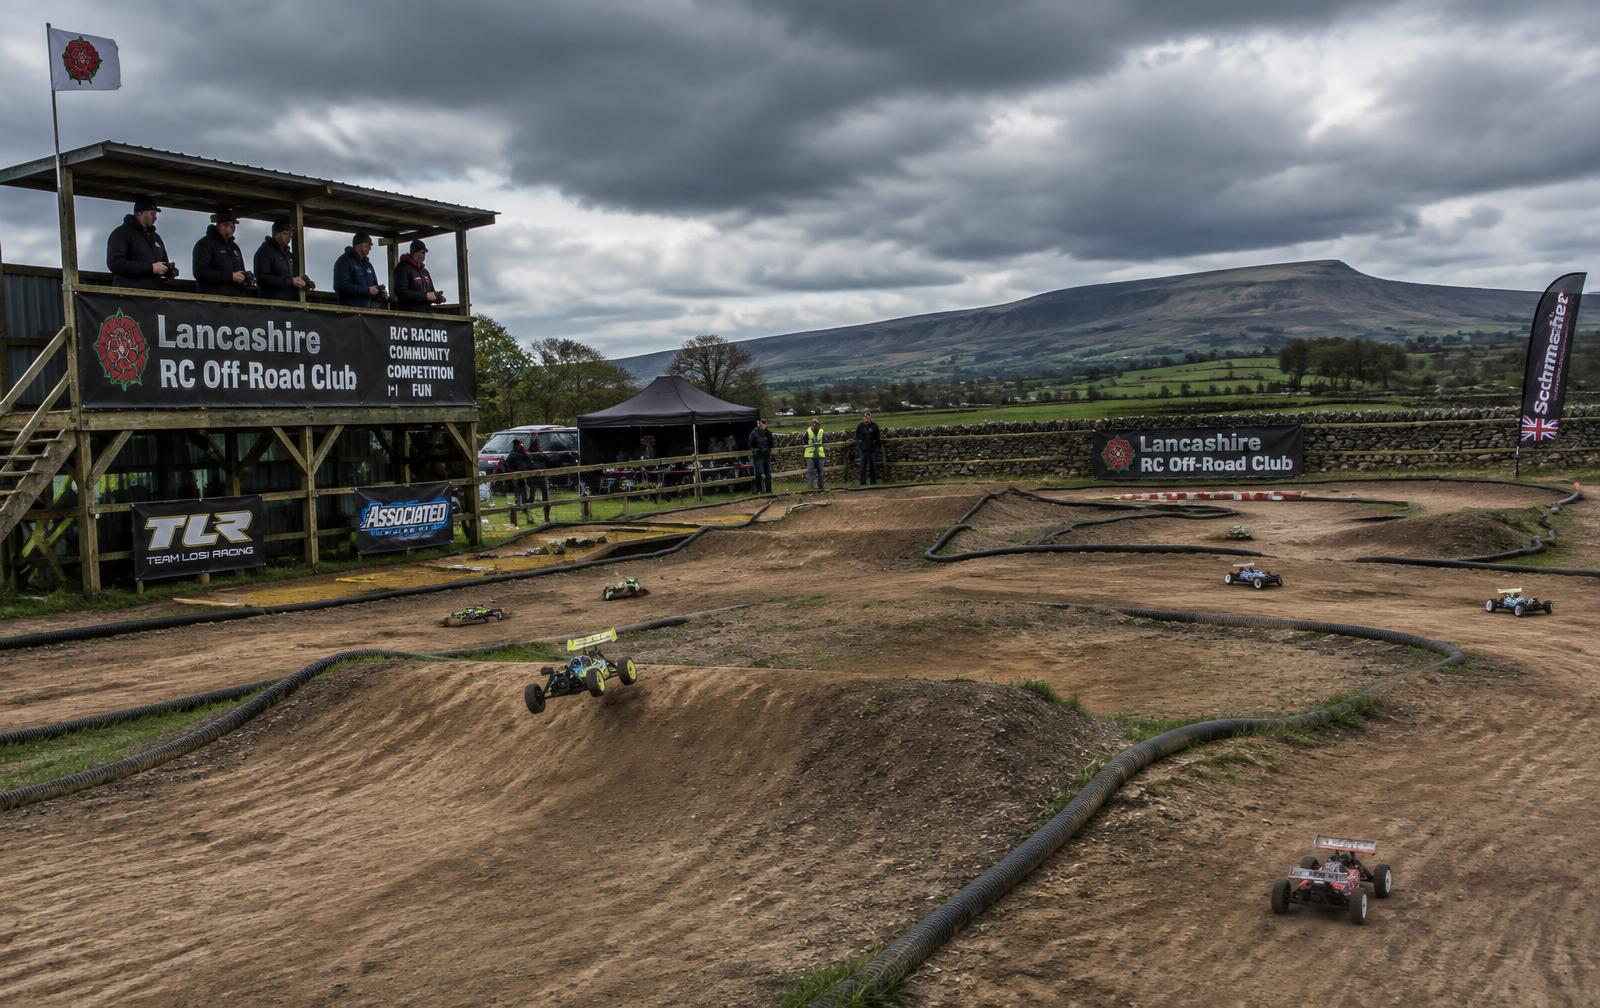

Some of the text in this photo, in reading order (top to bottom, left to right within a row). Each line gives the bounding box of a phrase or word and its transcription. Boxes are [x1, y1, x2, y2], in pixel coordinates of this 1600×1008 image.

[158, 314, 321, 353] Lancashire
[390, 326, 448, 343] R/C RACING
[389, 345, 450, 361] COMMUNITY
[160, 359, 196, 389] RC
[203, 361, 304, 391] Off-Road
[311, 364, 358, 392] Club
[387, 364, 454, 380] COMPETITION
[412, 383, 432, 397] FUN
[1140, 433, 1261, 452] Lancashire
[1141, 455, 1294, 472] RC Off-Road Club
[144, 510, 253, 550] TLR
[146, 546, 254, 566] TEAM LOSI RACING
